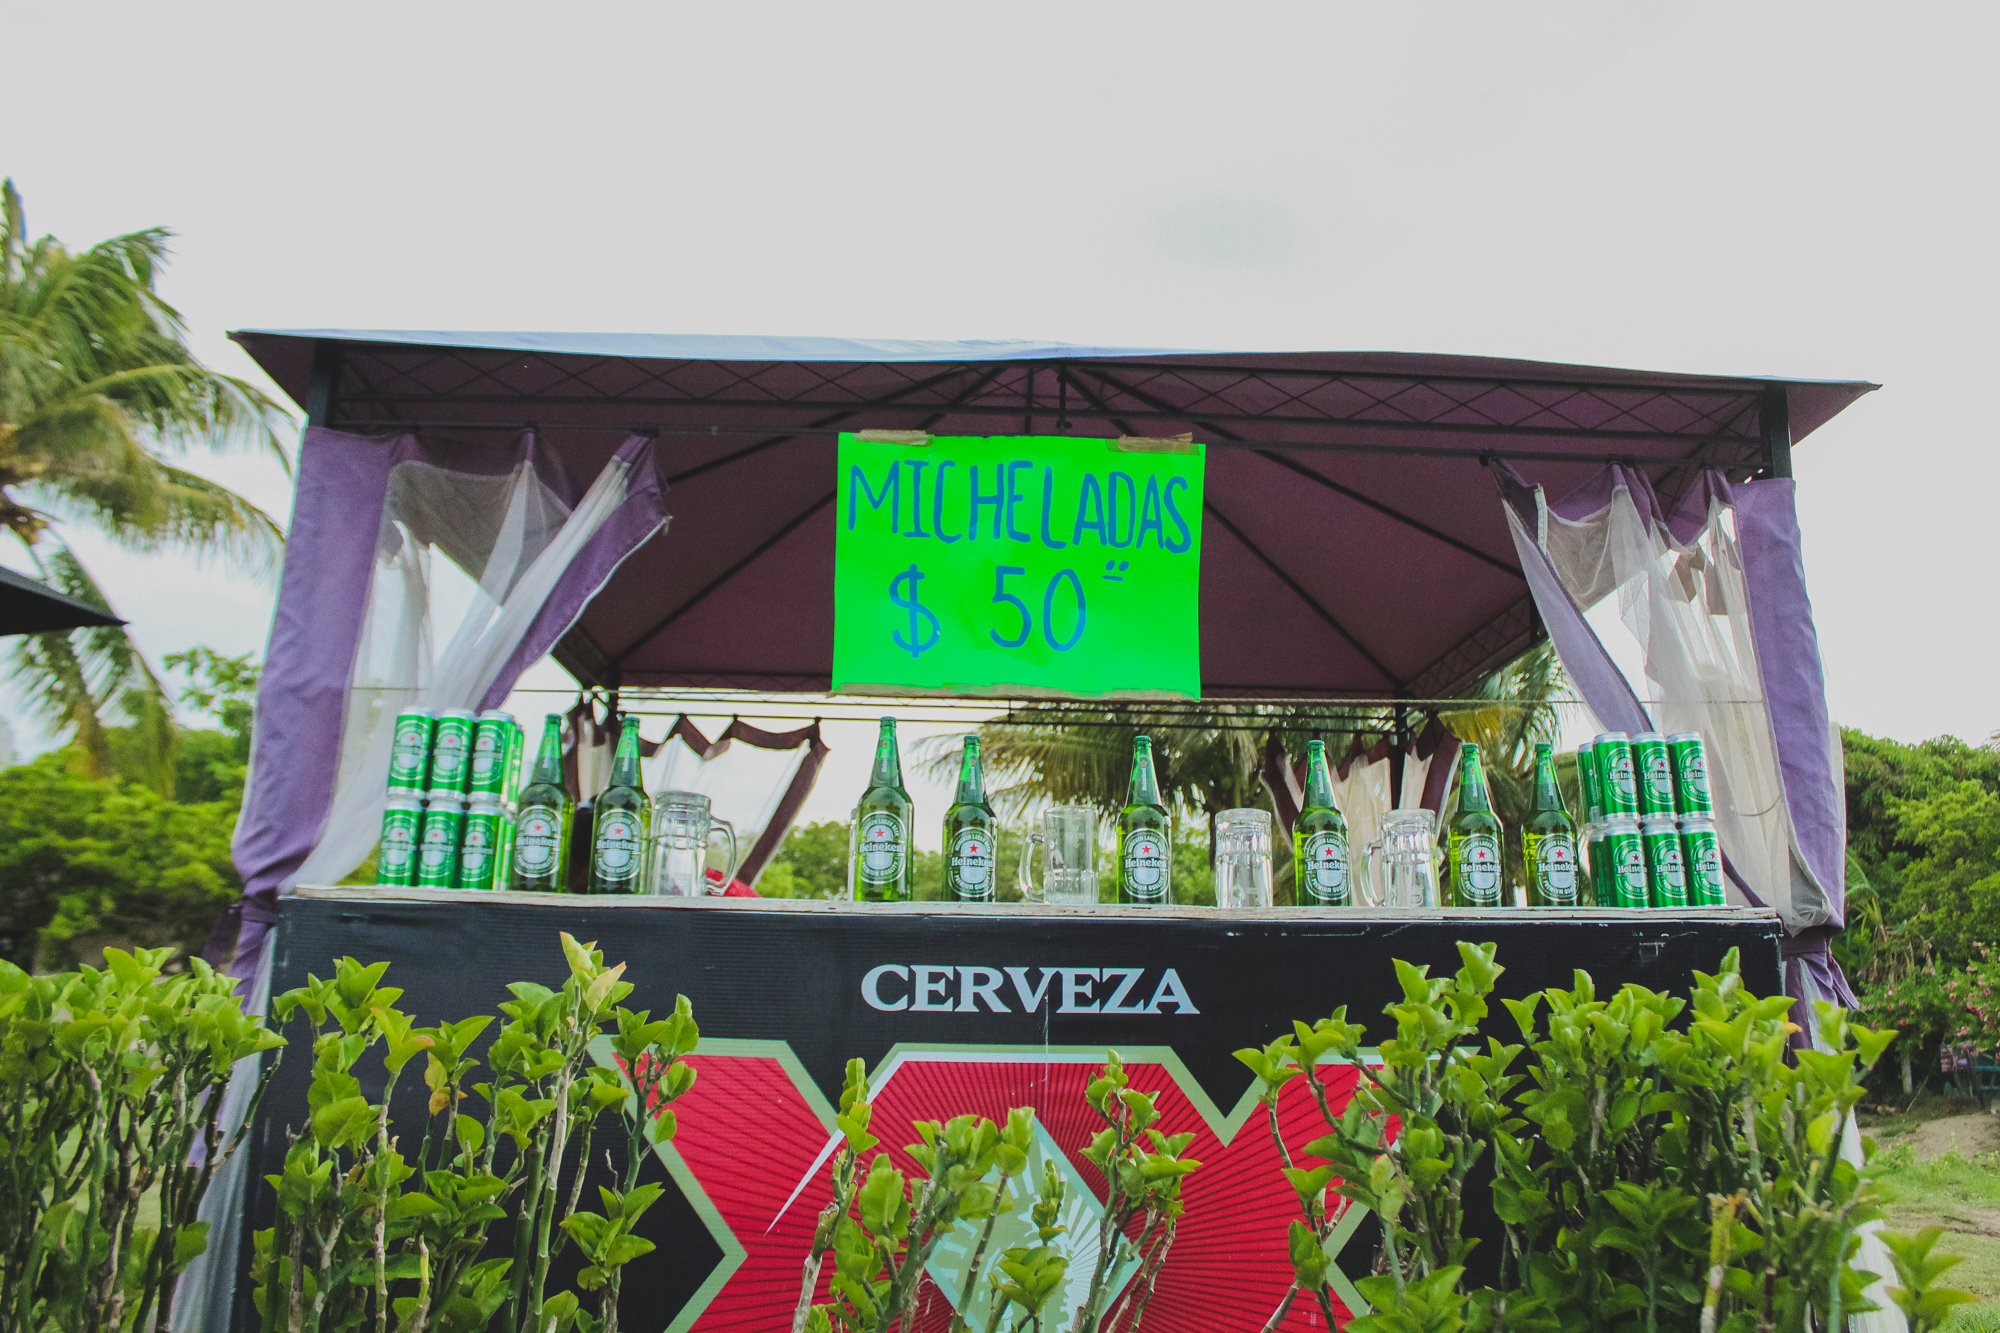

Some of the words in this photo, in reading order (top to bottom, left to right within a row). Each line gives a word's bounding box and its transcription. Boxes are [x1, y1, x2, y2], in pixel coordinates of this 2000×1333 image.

[848, 460, 1193, 554] MICHELADAS
[888, 563, 941, 658] $
[858, 842, 904, 853] Heineken
[951, 856, 994, 868] Heineken
[1124, 857, 1168, 869] Heineken
[1307, 860, 1349, 870] Heineken
[1460, 862, 1502, 873] Heineken
[1538, 862, 1579, 872] Heineken
[860, 963, 1202, 1015] CERVEZA
